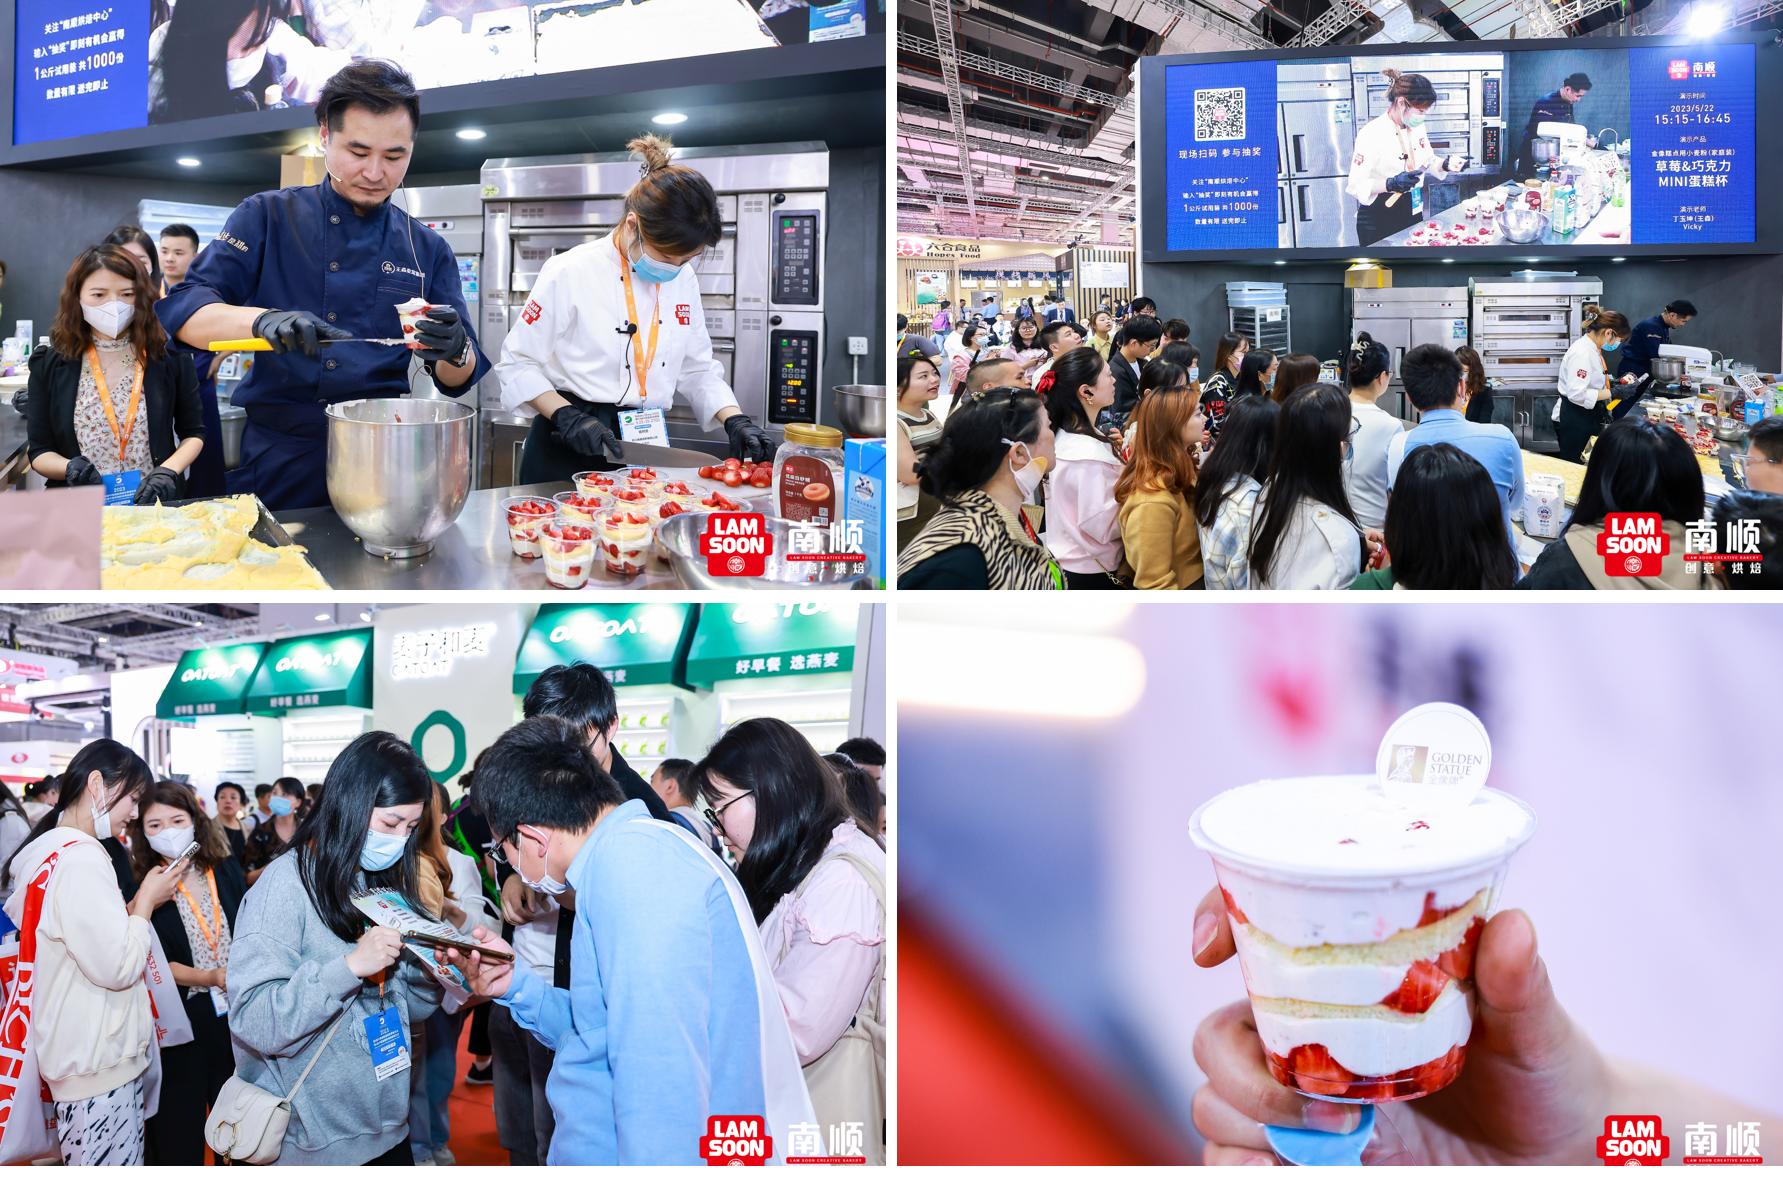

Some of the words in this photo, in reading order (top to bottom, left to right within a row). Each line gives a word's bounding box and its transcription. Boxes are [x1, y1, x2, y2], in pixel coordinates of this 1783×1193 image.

[1670, 104, 1714, 112] 2023/5/22
[1655, 113, 1731, 124] 15:15-16:45
[1179, 149, 1217, 159] 现场扫码
[1222, 147, 1261, 157] 参与抽奖
[1655, 160, 1731, 173] 草莓&巧克力
[1658, 175, 1728, 188] MINI蛋糕杯
[926, 243, 981, 253] 六合食品
[736, 657, 781, 674] 好早餐
[790, 652, 839, 670] 选燕麦
[1431, 752, 1482, 765] GOLDEN
[1431, 764, 1472, 775] STATUE
